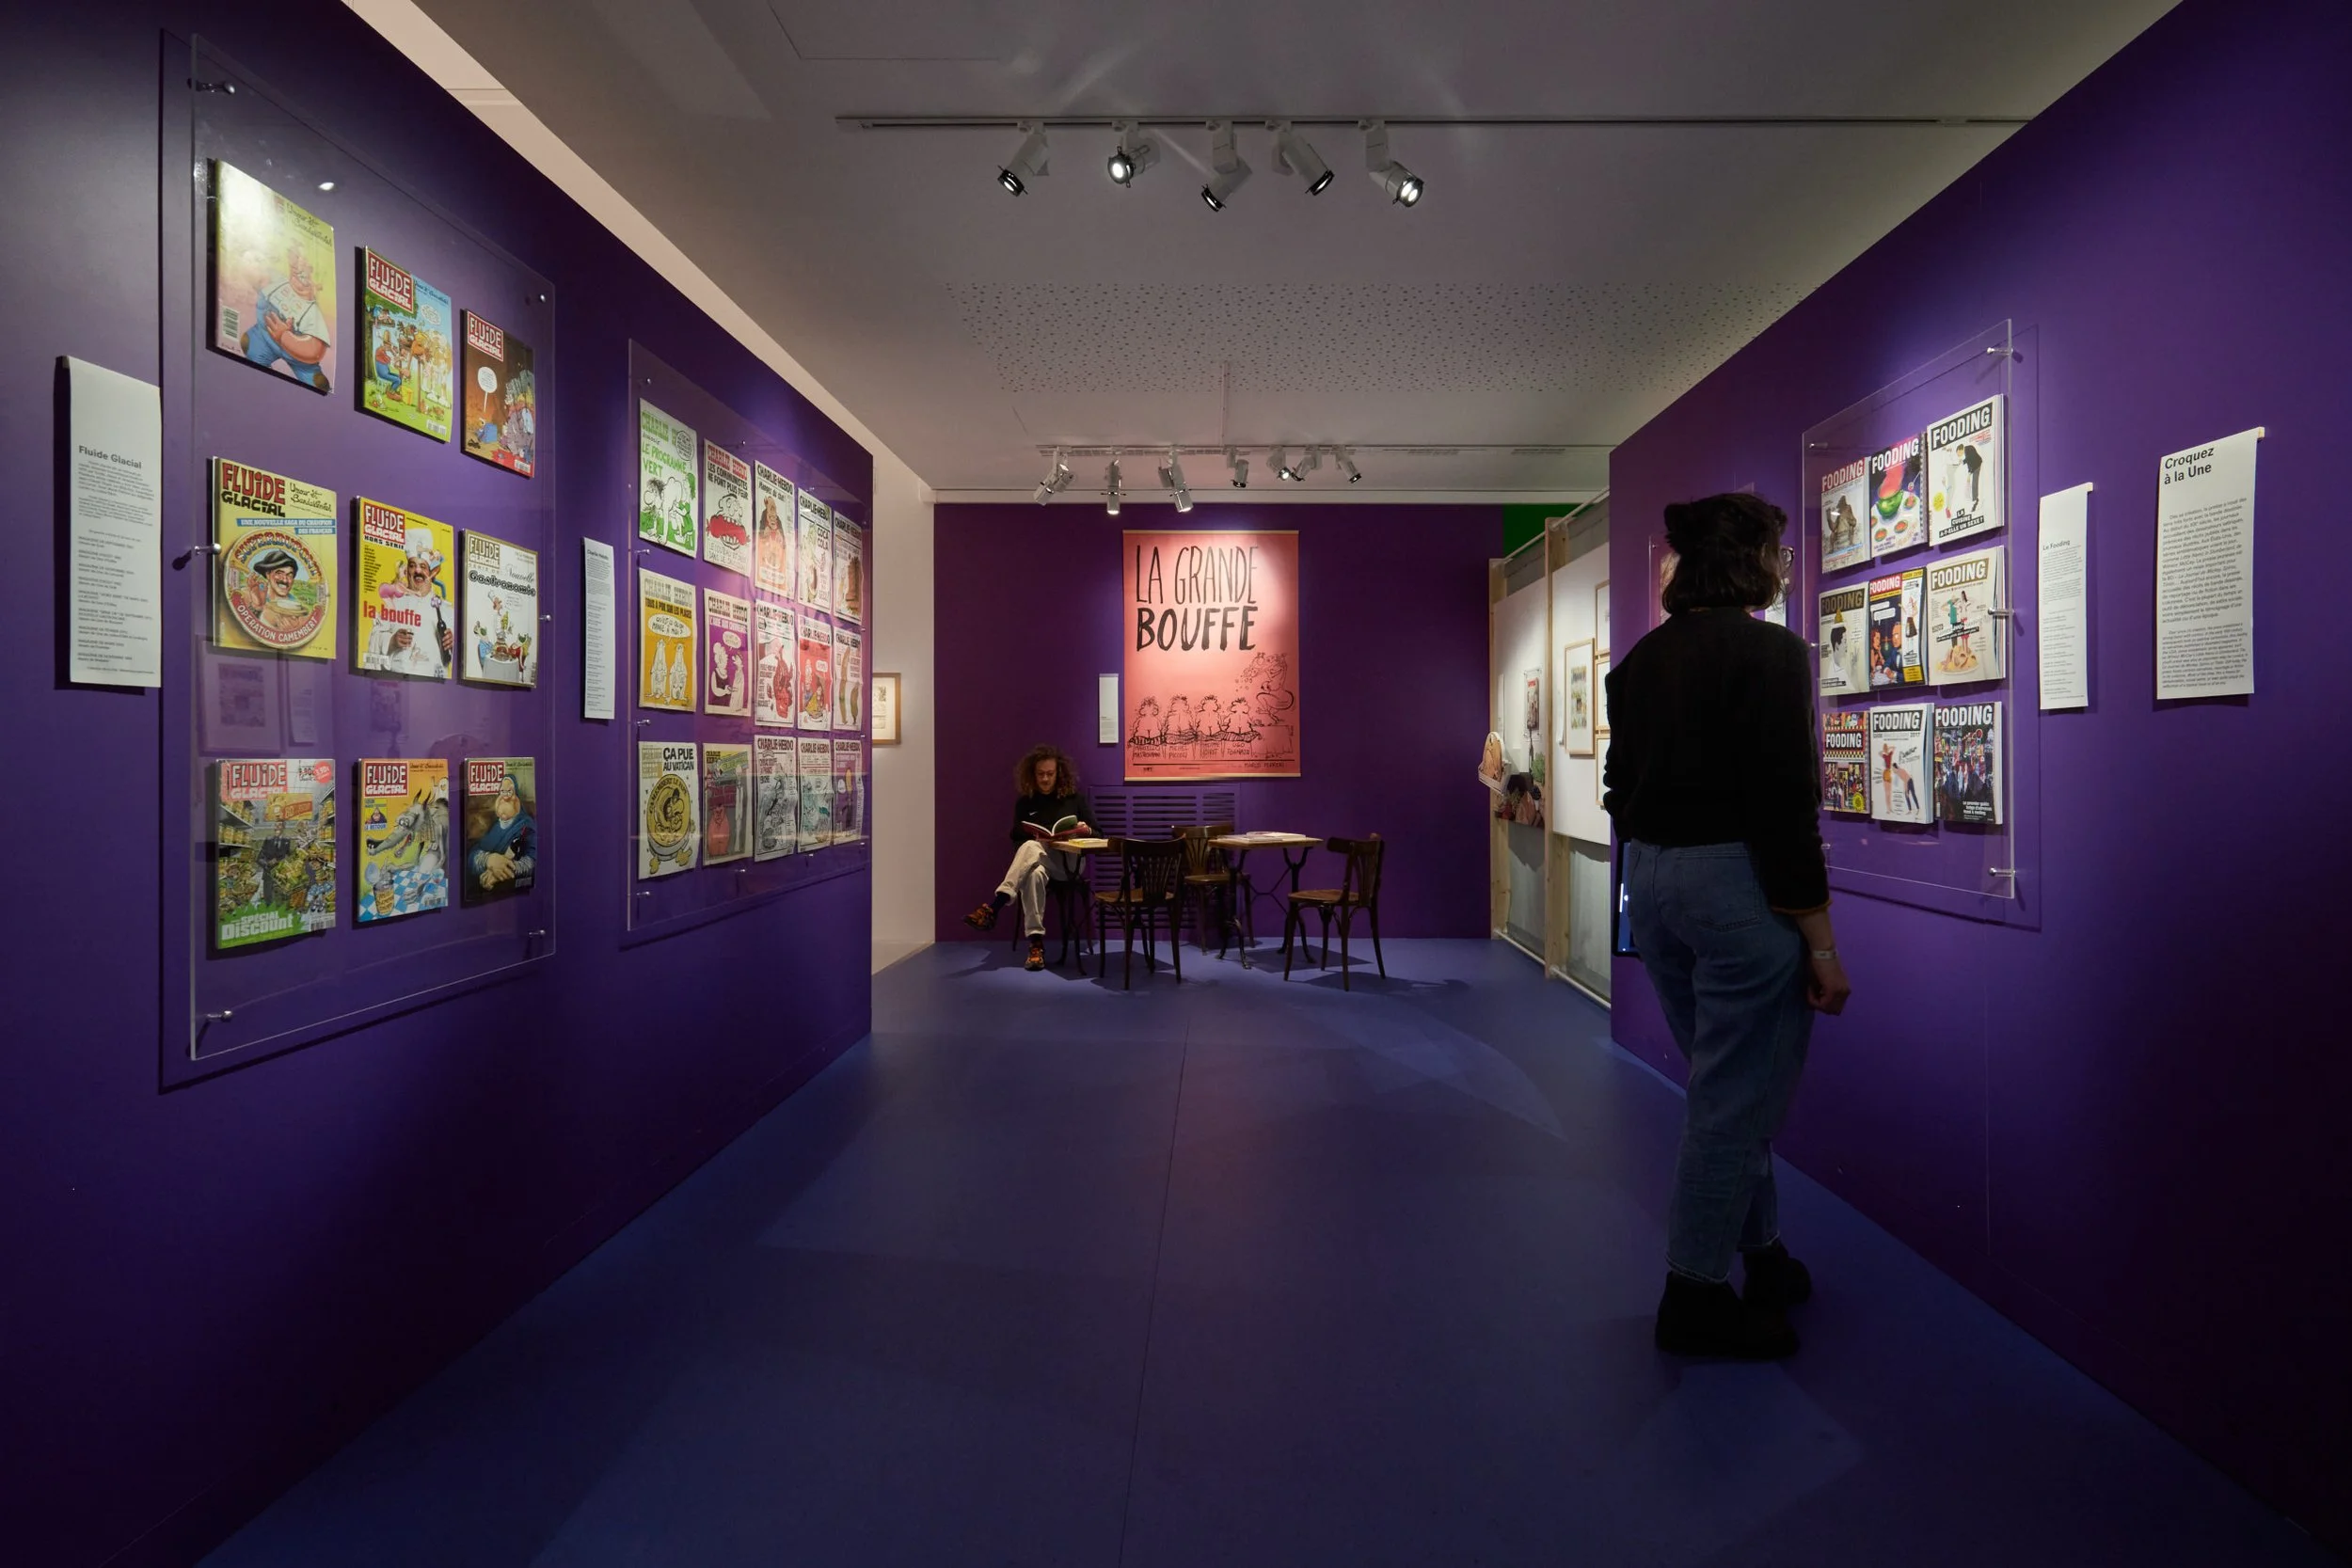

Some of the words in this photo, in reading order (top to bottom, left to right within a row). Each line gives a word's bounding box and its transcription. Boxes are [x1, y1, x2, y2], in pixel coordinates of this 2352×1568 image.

[1931, 406, 1991, 450] FOODING
[78, 445, 108, 460] Fluide
[110, 453, 142, 468] Glacial
[1871, 436, 1919, 475] FOODING
[2165, 448, 2215, 469] Croquez
[707, 461, 716, 473] LES
[1821, 460, 1863, 492] FOODING
[2164, 473, 2171, 484] à
[2174, 470, 2185, 483] la
[2187, 463, 2212, 478] Une
[2049, 539, 2071, 549] Fooding
[1136, 545, 1164, 605] LA
[1174, 546, 1259, 605] GRANDE
[1869, 575, 1901, 595] FOODING
[1931, 561, 1986, 590] FOODING
[363, 600, 375, 619] la
[380, 604, 421, 627] bouffe
[1820, 590, 1864, 615] FOODING
[278, 616, 318, 642] CAMEMBERT
[1136, 605, 1259, 652] BOUFFE
[1873, 711, 1920, 731] FOODING
[1935, 705, 1994, 727] FOODING
[1825, 732, 1863, 749] FOODING
[663, 748, 676, 761] ÇA
[677, 748, 693, 760] PUE
[663, 761, 672, 771] AU
